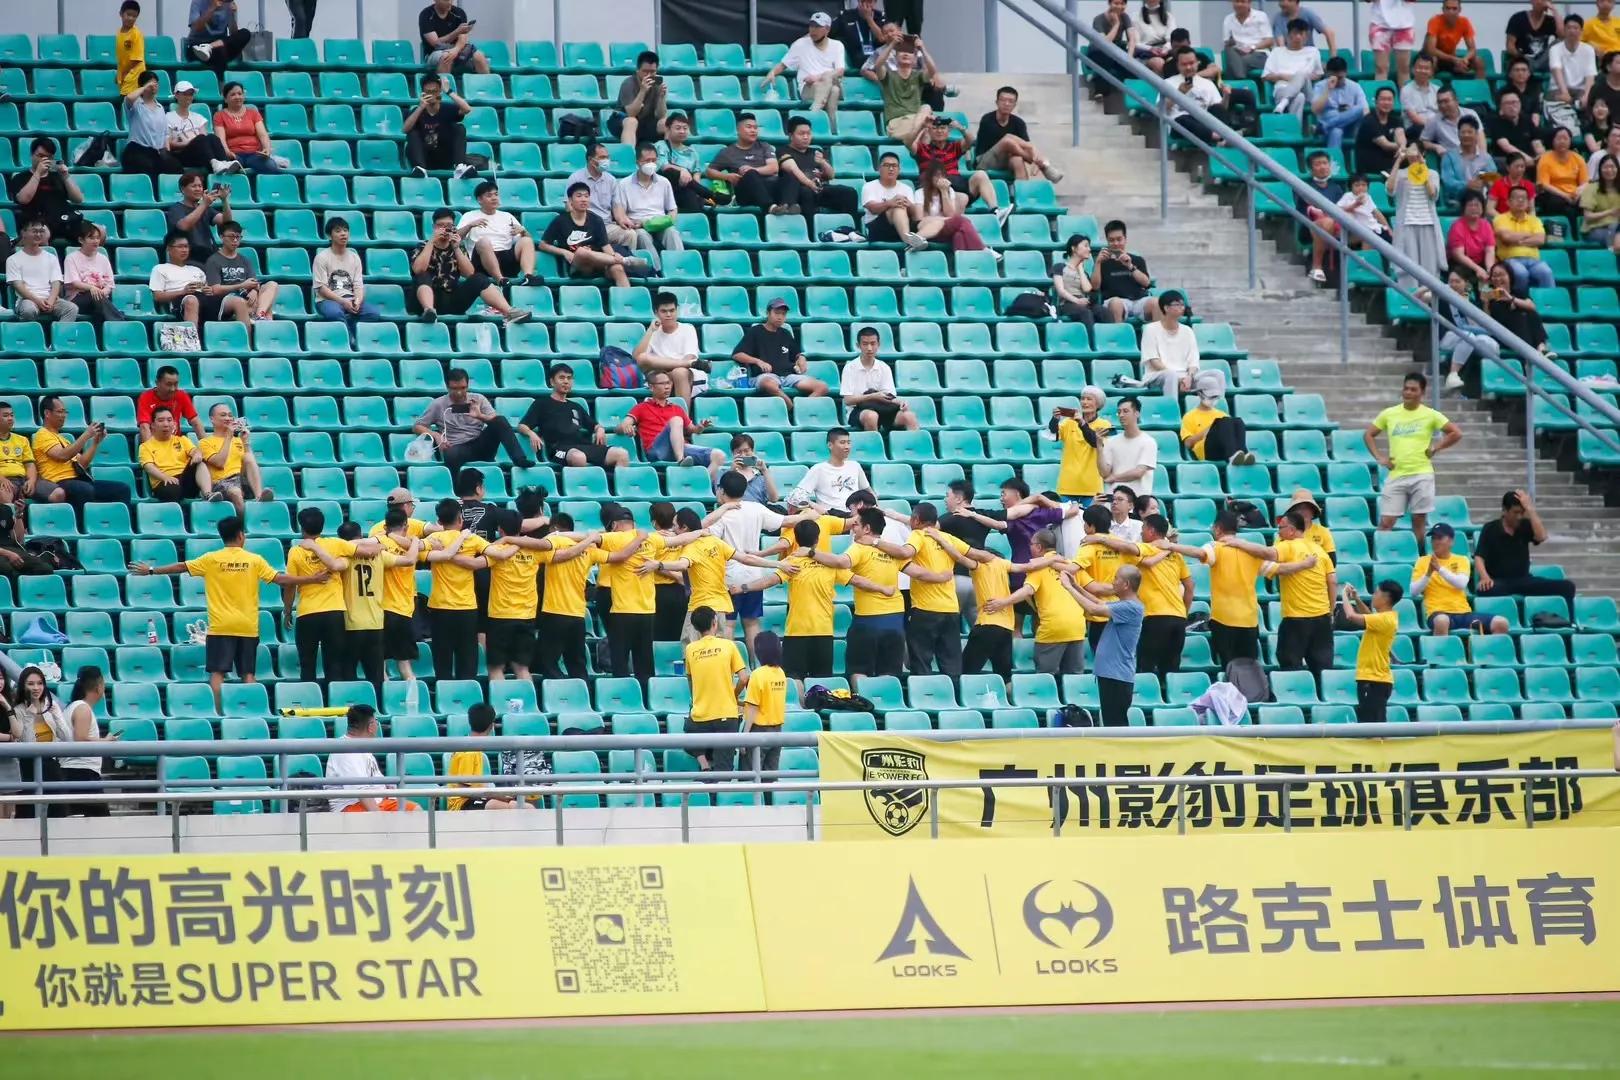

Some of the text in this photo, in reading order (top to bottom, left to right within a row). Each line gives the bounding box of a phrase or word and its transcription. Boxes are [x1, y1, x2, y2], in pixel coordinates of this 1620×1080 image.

[354, 563, 375, 597] 12
[877, 772, 909, 781] POWER
[978, 756, 1584, 829] 广州影豹足球俱乐部
[0, 864, 475, 949] 你的高光时刻
[1162, 872, 1598, 955] 路克士体育
[355, 957, 483, 1000] STAR
[892, 964, 958, 977] LOOKS
[1035, 958, 1119, 975] LOOKS
